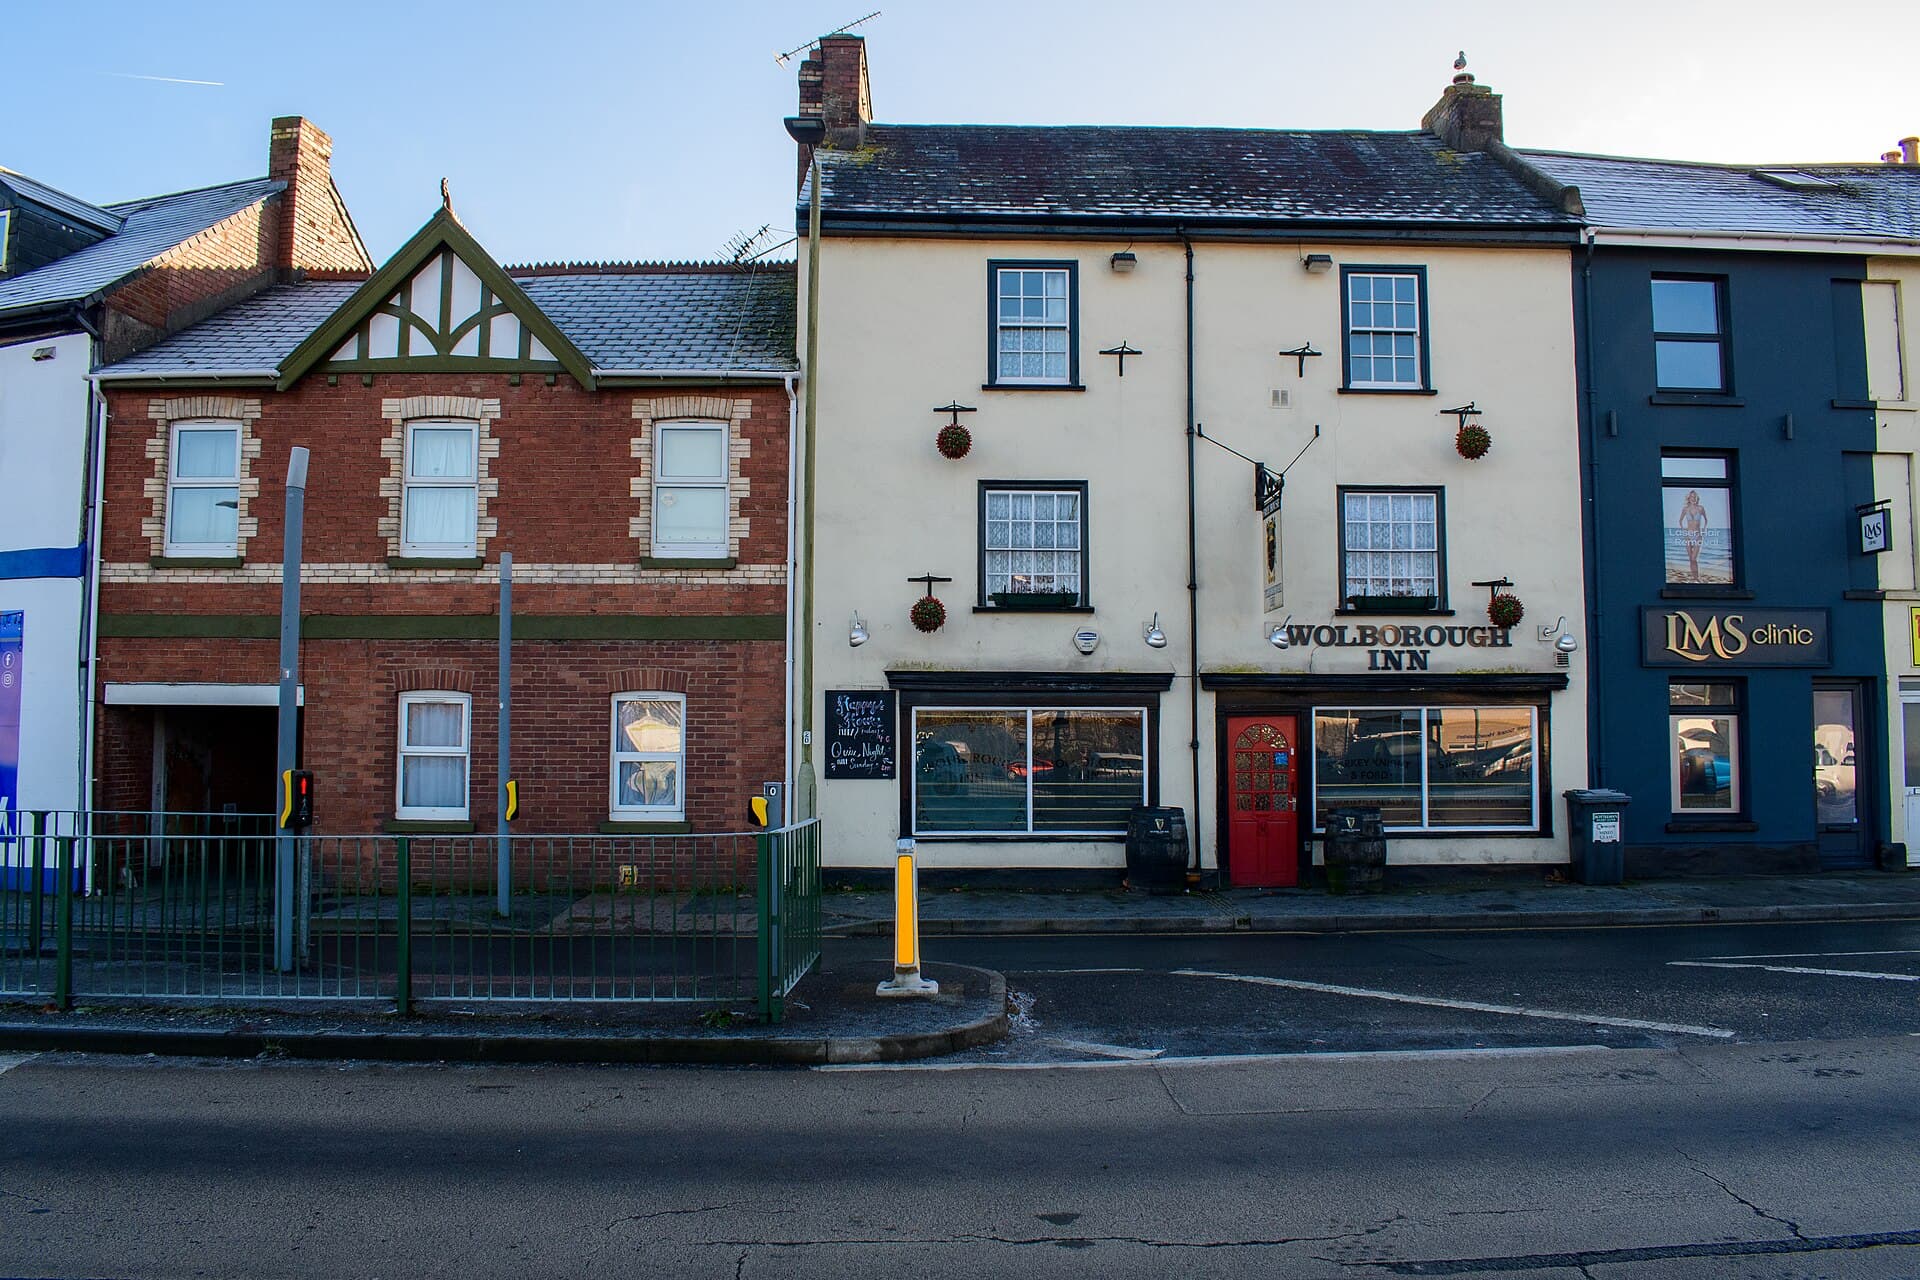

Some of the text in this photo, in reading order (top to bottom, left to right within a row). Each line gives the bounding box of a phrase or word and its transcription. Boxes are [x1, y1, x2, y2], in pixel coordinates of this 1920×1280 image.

[1669, 528, 1720, 537] Laser Hair
[1863, 522, 1882, 540] LMS
[1287, 624, 1512, 648] WOLBOROUGH
[1664, 611, 1813, 661] LMS clinic
[1367, 650, 1430, 671] INN
[1327, 759, 1370, 769] SRKEY
